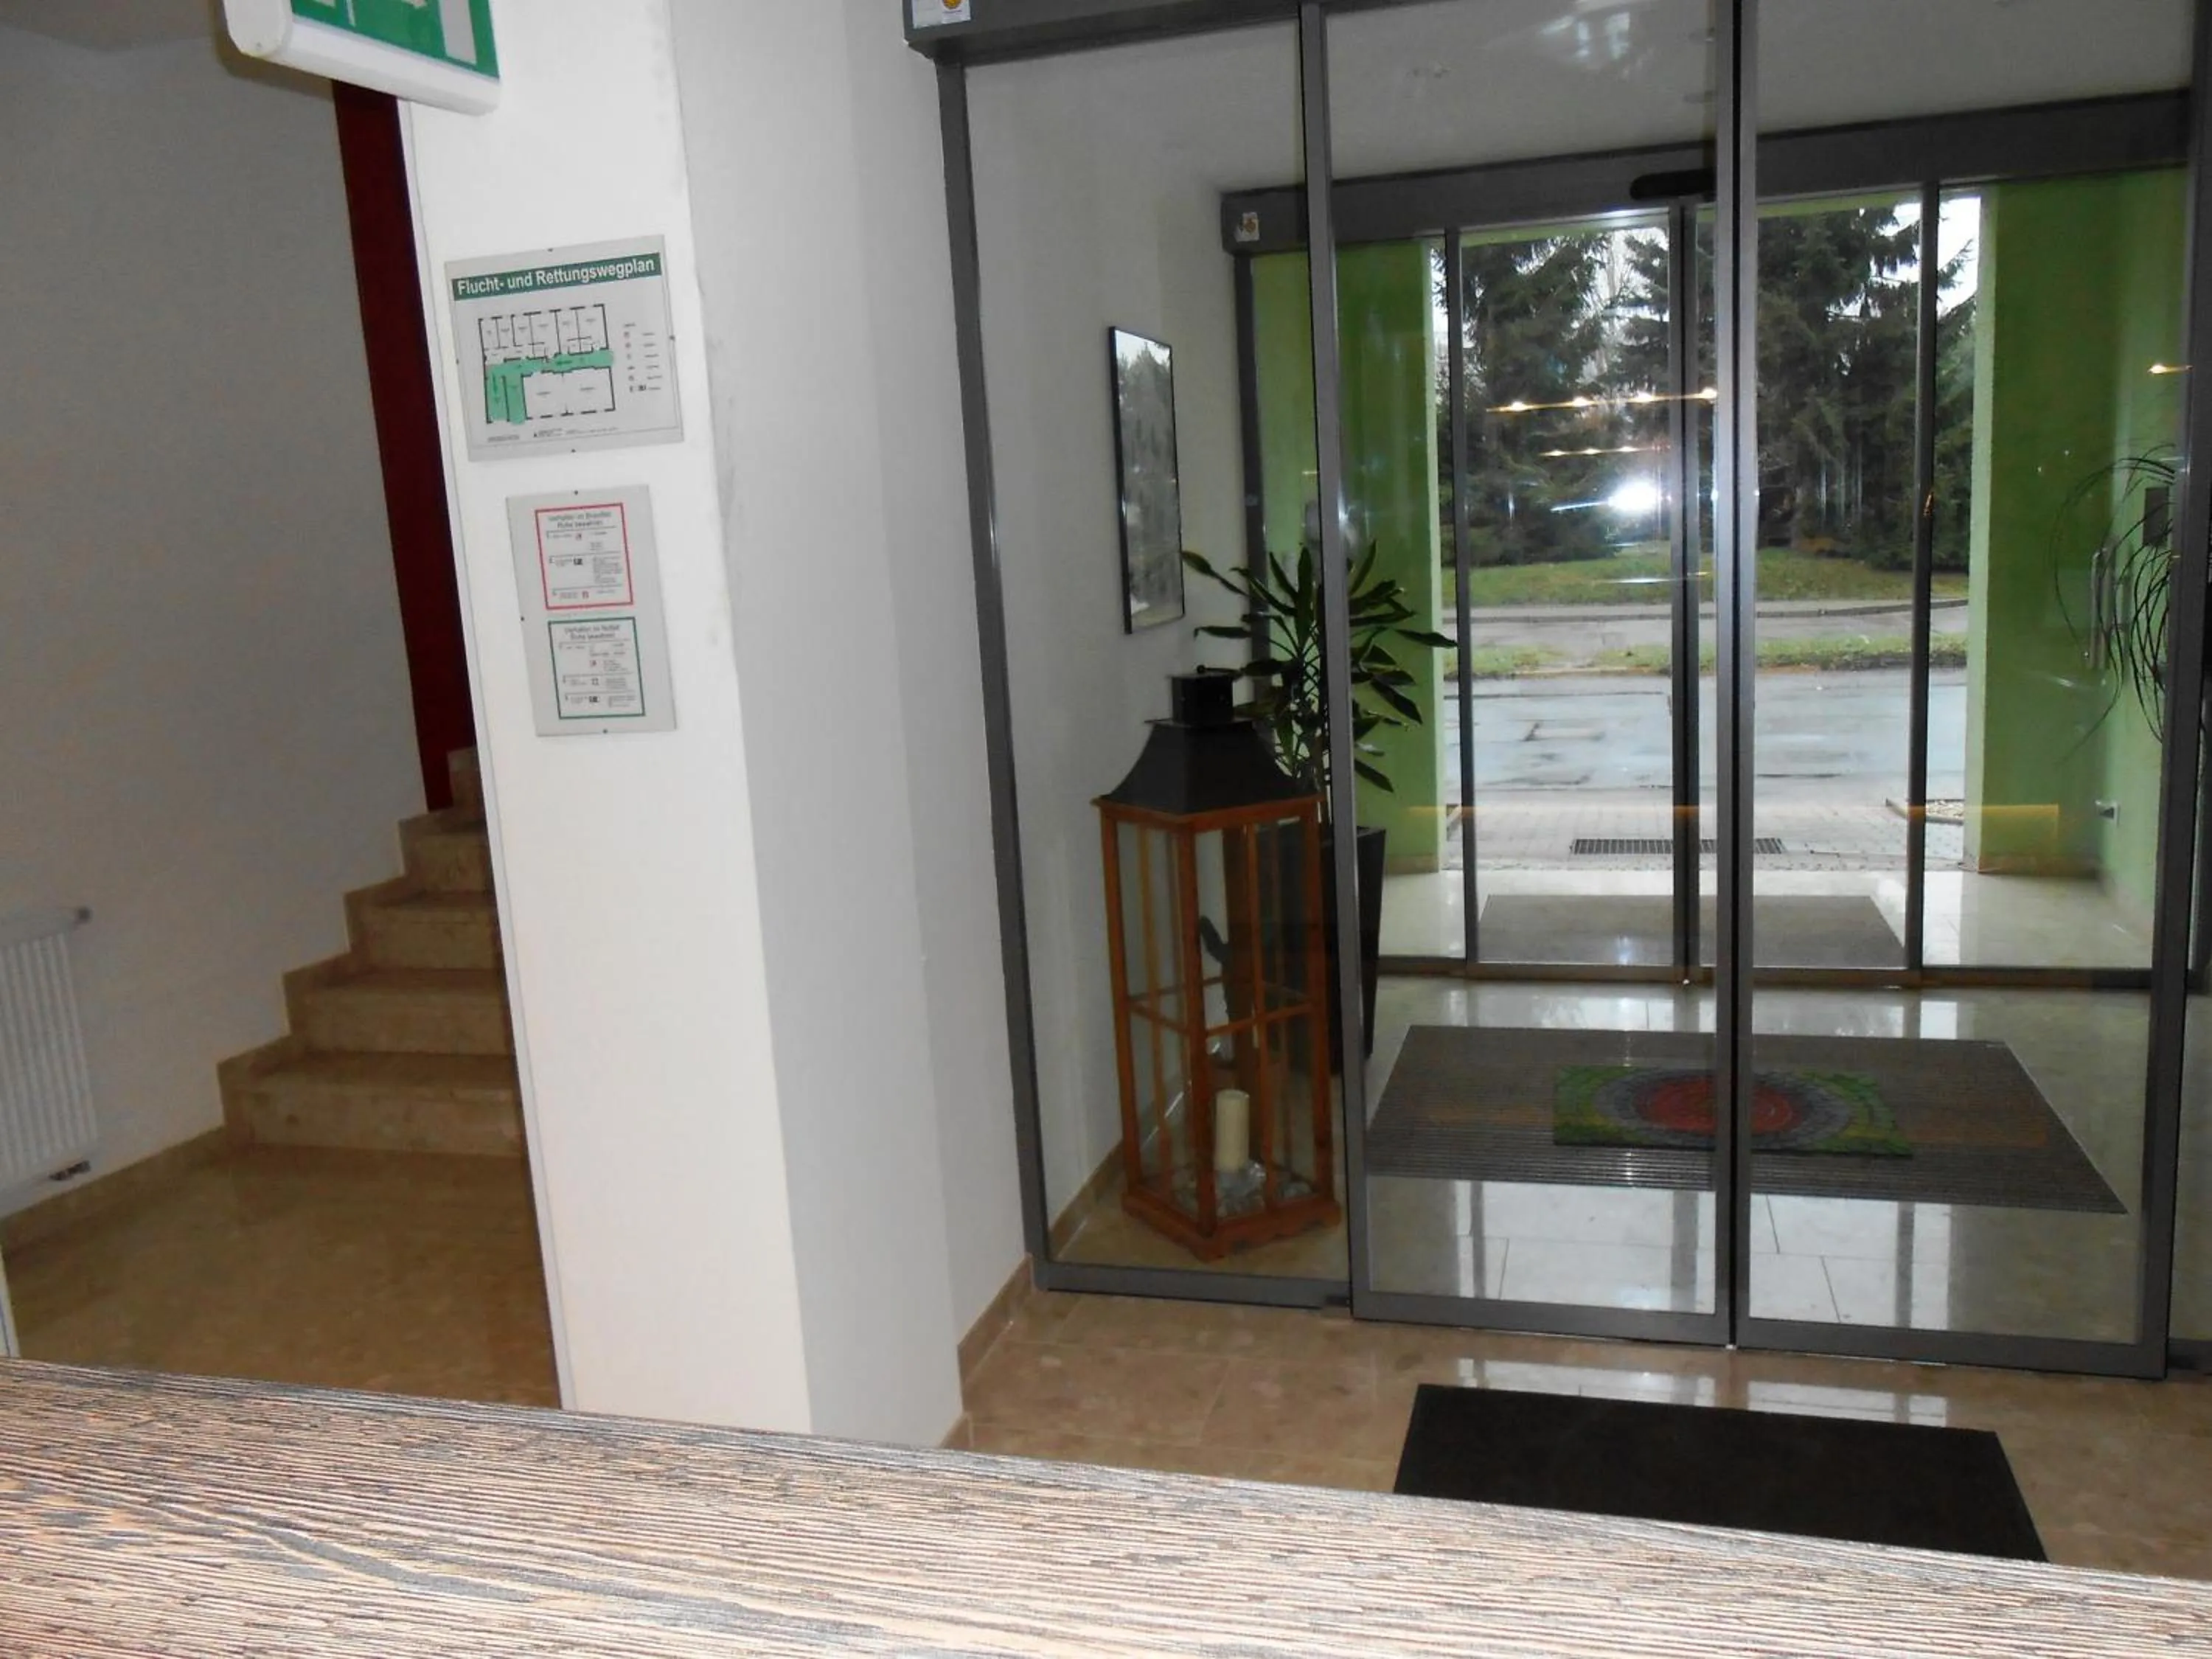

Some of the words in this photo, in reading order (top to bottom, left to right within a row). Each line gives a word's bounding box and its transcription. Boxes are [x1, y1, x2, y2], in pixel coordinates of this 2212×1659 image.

[457, 278, 504, 295] Flucht-
[507, 273, 532, 290] und
[536, 258, 655, 285] Rettungswegplan
